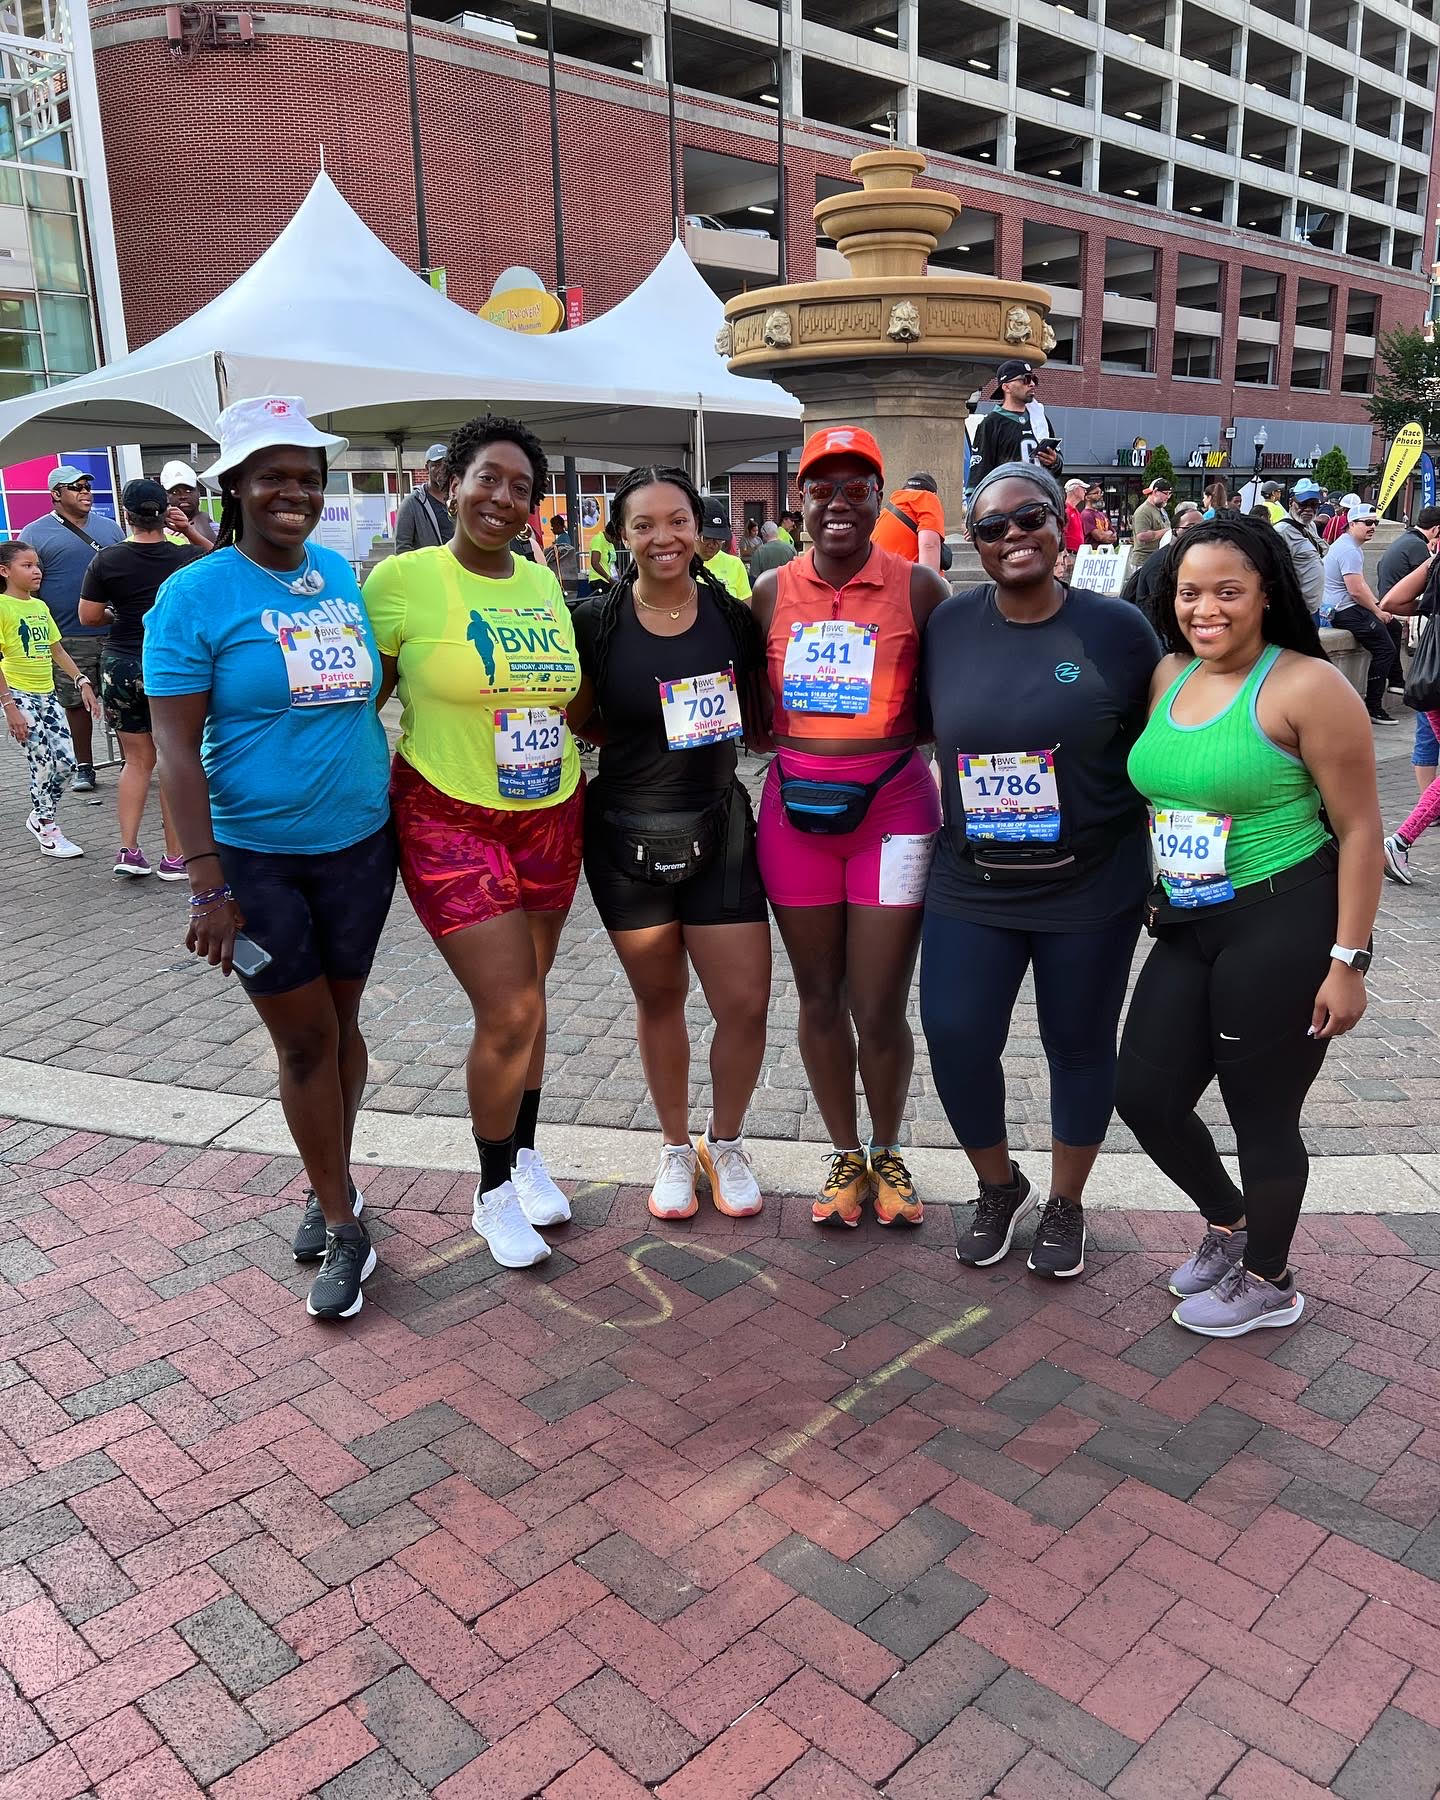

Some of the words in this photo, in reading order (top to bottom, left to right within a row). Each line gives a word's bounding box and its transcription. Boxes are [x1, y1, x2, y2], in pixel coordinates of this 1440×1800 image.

[1402, 429, 1420, 437] Race
[1396, 437, 1422, 445] Photos
[321, 507, 350, 521] JOIN
[1081, 560, 1118, 577] PACKET
[1077, 577, 1116, 593] PICK-UP
[320, 627, 340, 637] BWC
[826, 625, 844, 633] BWC
[497, 627, 570, 654] BWC
[309, 646, 357, 671] 823
[805, 642, 851, 664] 541
[321, 672, 354, 682] Patrice
[698, 678, 714, 688] BWC
[684, 694, 726, 720] 702
[792, 700, 808, 708] 541
[694, 719, 723, 731] Shirley
[511, 726, 559, 752] 1423
[997, 757, 1016, 766] BWC
[975, 774, 1041, 796] 1786
[1001, 798, 1018, 806] Olu
[1174, 815, 1193, 823] BWC
[1158, 834, 1209, 859] 1948
[655, 862, 686, 872] Supreme
